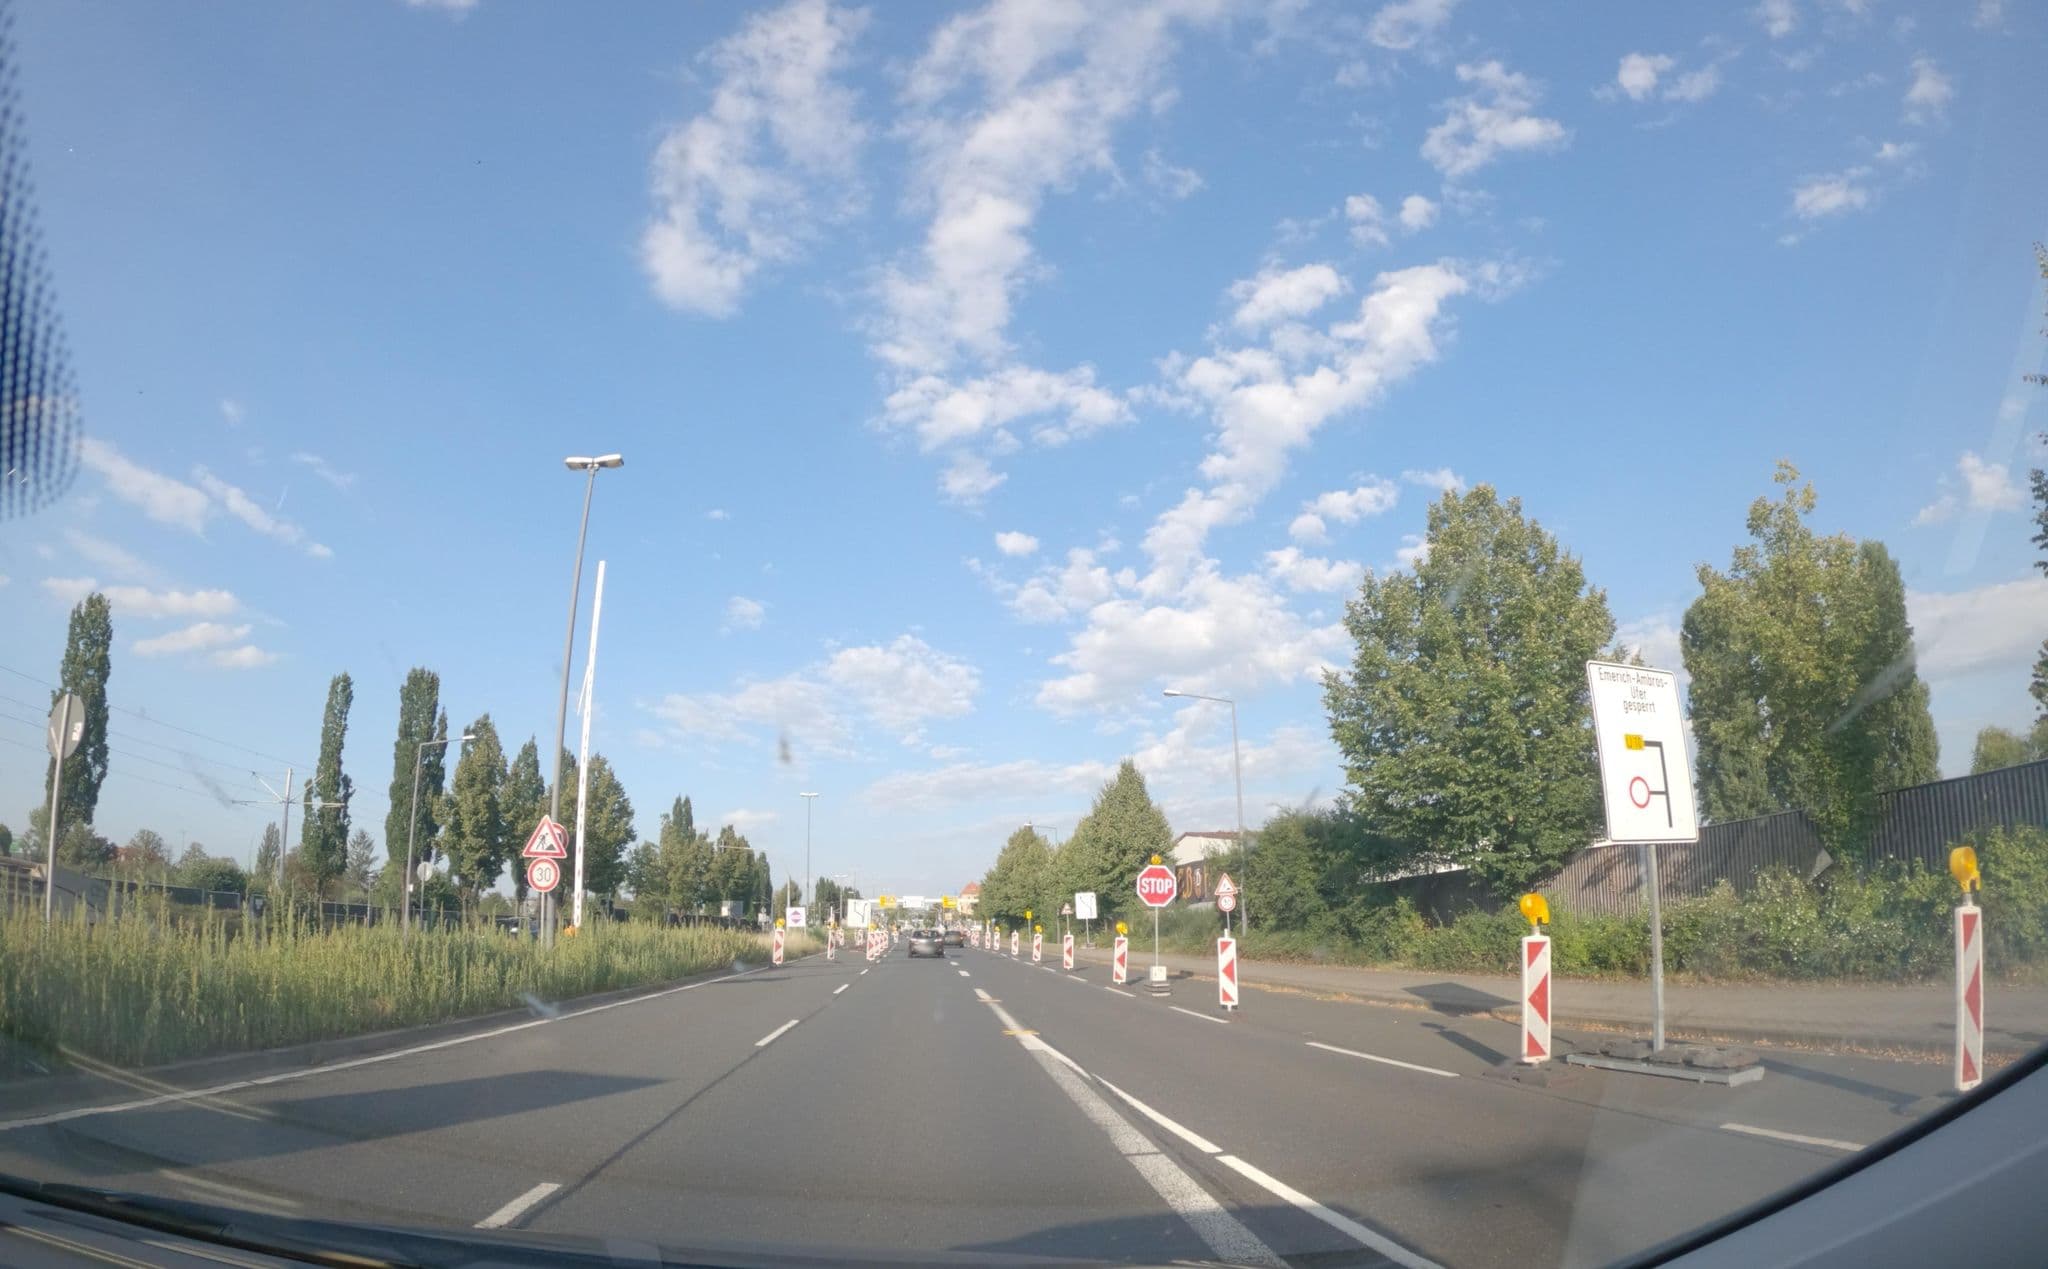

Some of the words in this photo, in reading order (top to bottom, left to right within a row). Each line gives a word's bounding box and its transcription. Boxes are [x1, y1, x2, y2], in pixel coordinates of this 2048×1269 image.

[1598, 666, 1668, 688] Emerich-Ambros-
[1630, 686, 1647, 700] Ufer
[1623, 700, 1656, 716] gesperrt
[536, 867, 551, 882] 30
[1141, 878, 1173, 894] STOP
